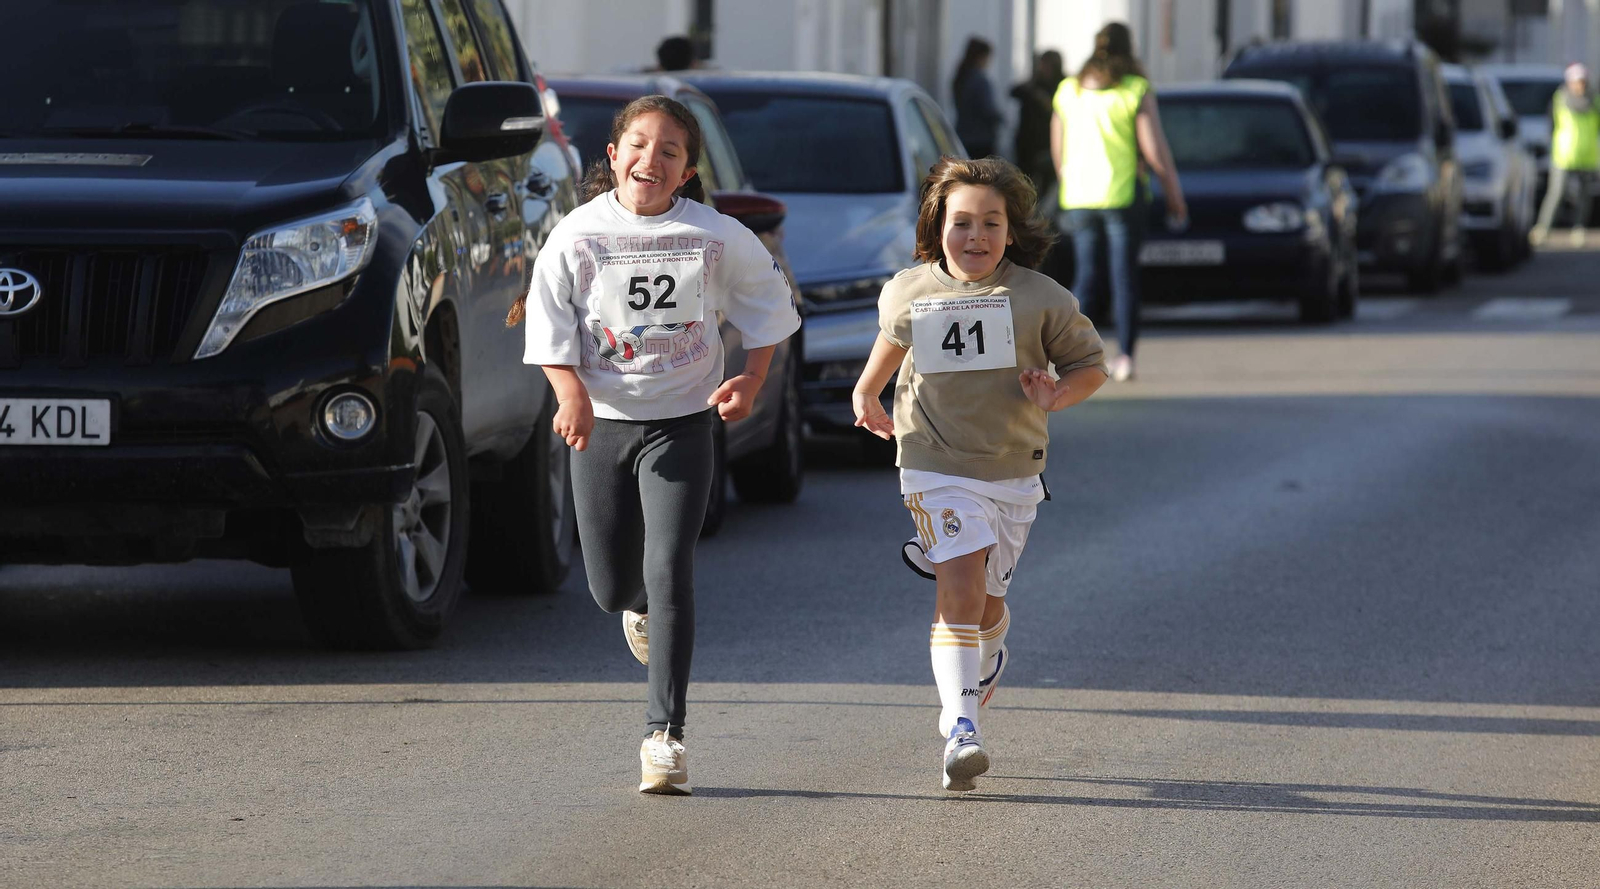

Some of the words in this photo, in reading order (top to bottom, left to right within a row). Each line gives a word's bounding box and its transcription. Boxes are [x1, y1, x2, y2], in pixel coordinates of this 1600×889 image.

[628, 274, 677, 311] 52
[942, 320, 985, 356] 41
[31, 405, 100, 439] KDL
